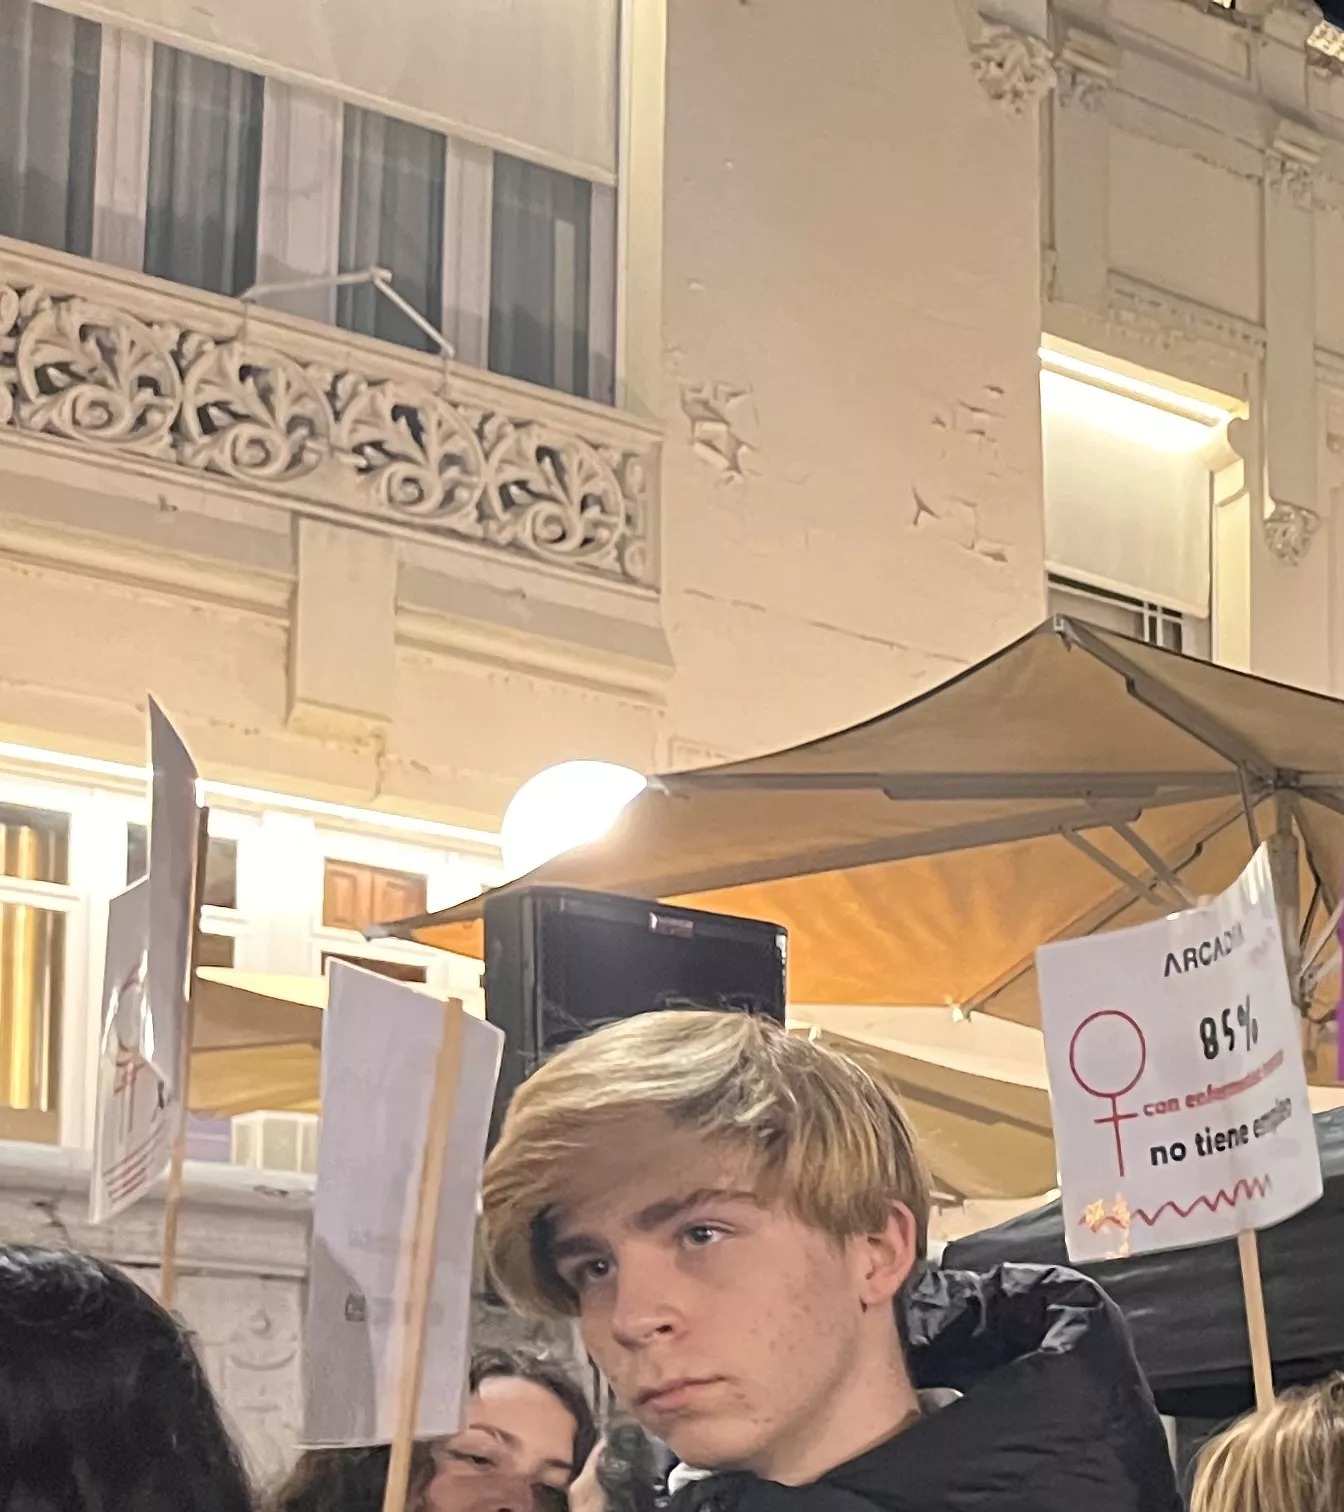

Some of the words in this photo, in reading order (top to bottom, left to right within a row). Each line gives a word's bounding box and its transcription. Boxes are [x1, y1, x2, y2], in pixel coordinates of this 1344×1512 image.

[1200, 994, 1258, 1060] 85%
[1150, 1142, 1186, 1166] no
[1195, 1124, 1248, 1156] tiene
